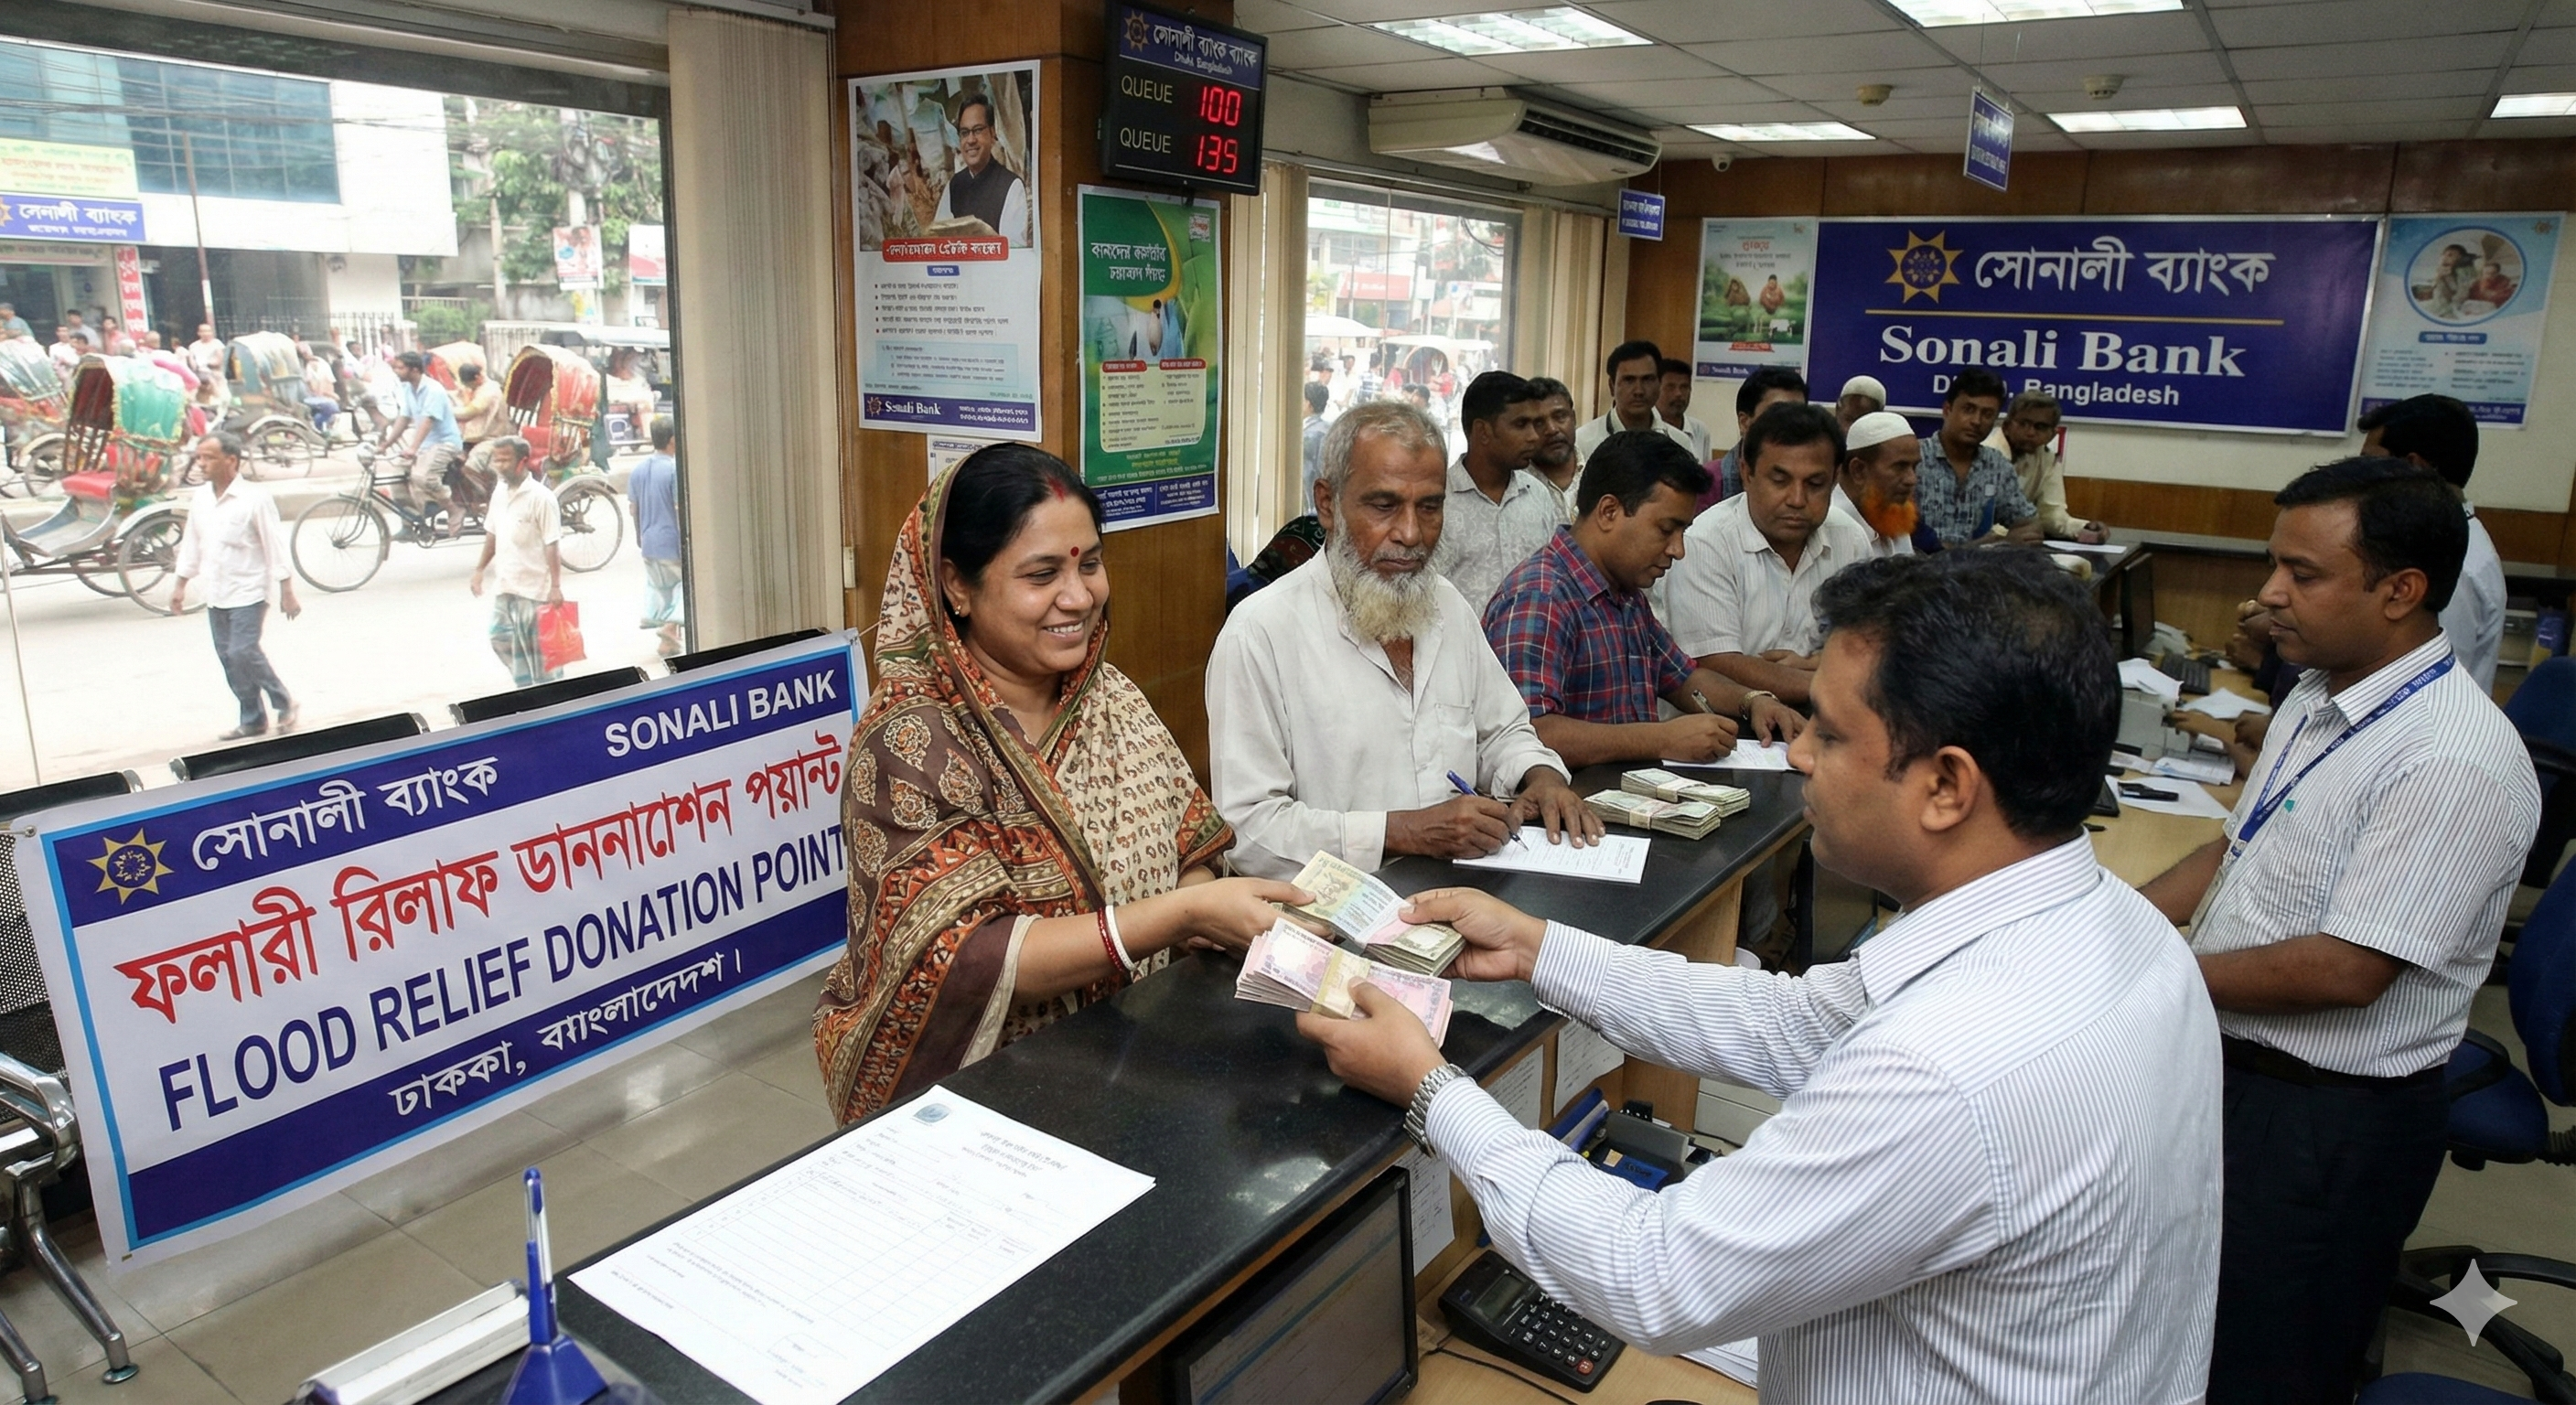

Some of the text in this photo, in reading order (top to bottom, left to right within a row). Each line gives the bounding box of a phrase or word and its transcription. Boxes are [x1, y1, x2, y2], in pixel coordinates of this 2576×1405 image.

[1122, 75, 1241, 126] QUEUE 100
[1120, 127, 1171, 154] QUEUE
[1975, 235, 2276, 295] সোনালী ব্যাংক
[1880, 325, 2247, 377] Sonali Bank
[916, 402, 941, 415] Bank
[606, 670, 836, 758] SONALI BANK
[192, 756, 499, 871] সোনালী ব্যাংক
[113, 885, 317, 1024] ফলারী
[329, 850, 499, 962] রিলাফ
[158, 823, 844, 1132] FLOOD RELIEF DONATION POINT
